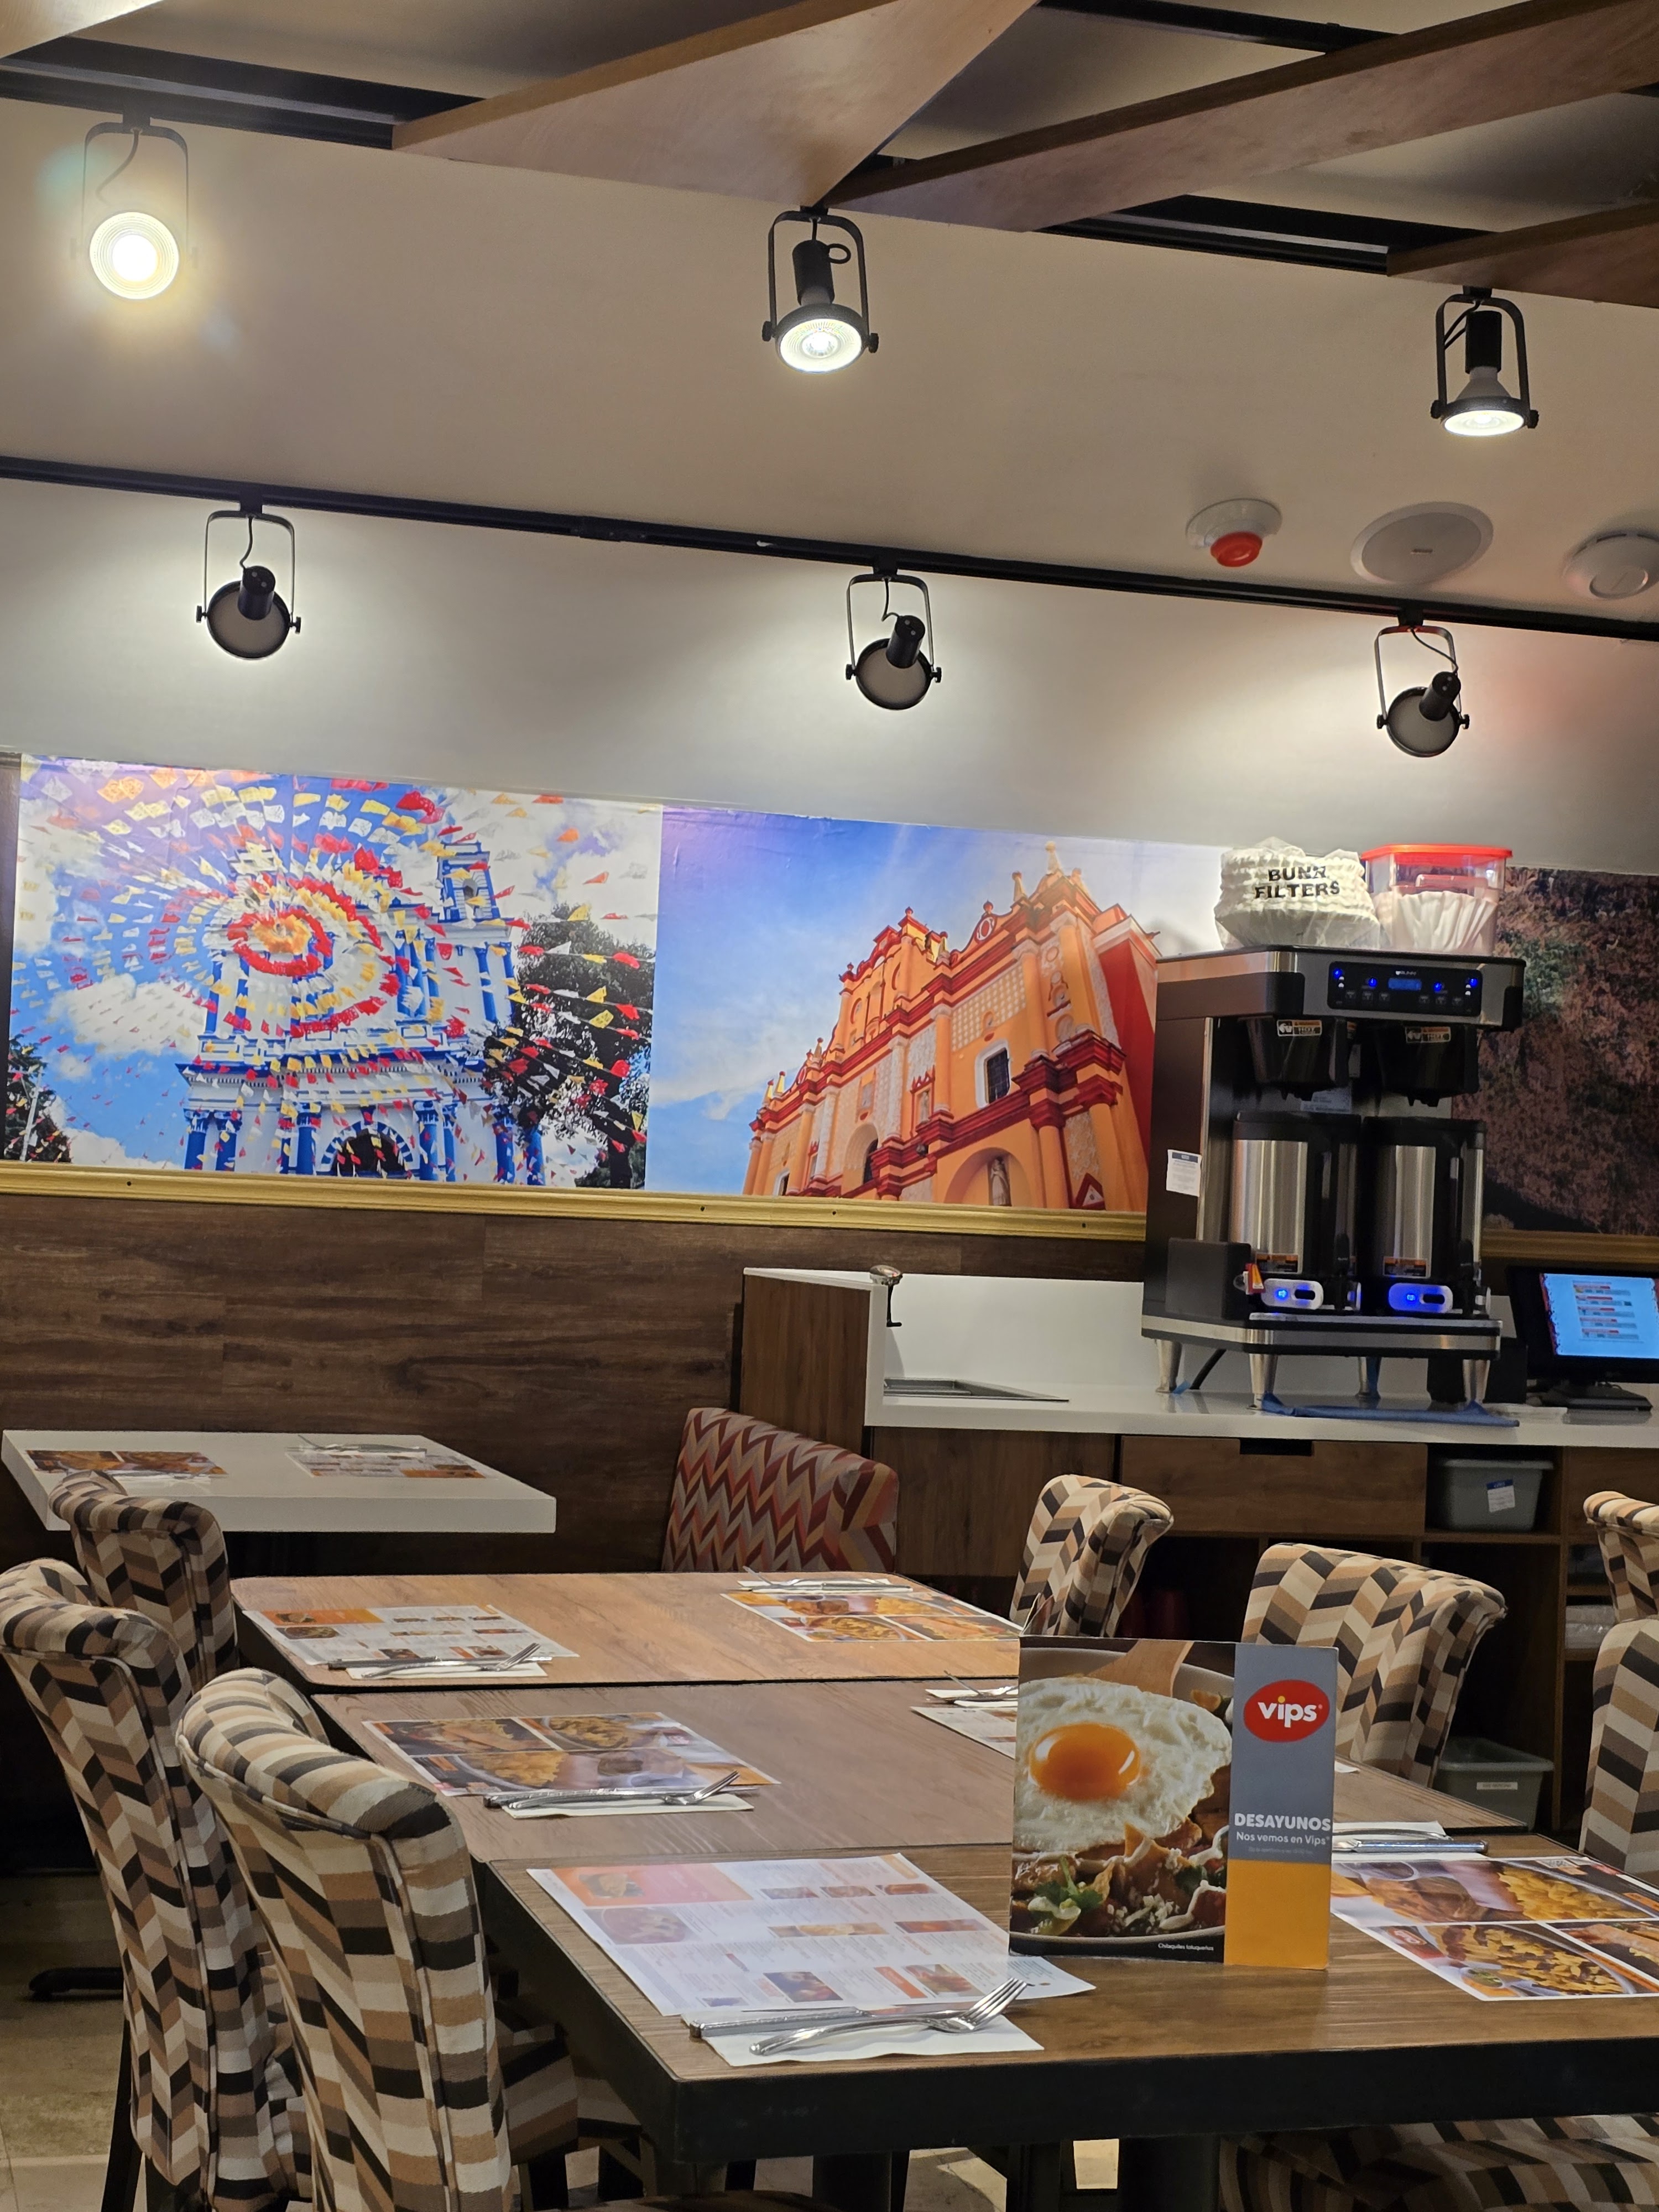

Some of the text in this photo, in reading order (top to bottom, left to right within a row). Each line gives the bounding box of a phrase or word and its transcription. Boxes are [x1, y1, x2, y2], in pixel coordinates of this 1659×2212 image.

[1254, 880, 1340, 899] FILTERS
[1258, 1695, 1317, 1728] vips
[1234, 1813, 1331, 1831] DESAYUNOS
[1236, 1832, 1255, 1841] Nos
[1256, 1834, 1288, 1843] vemos
